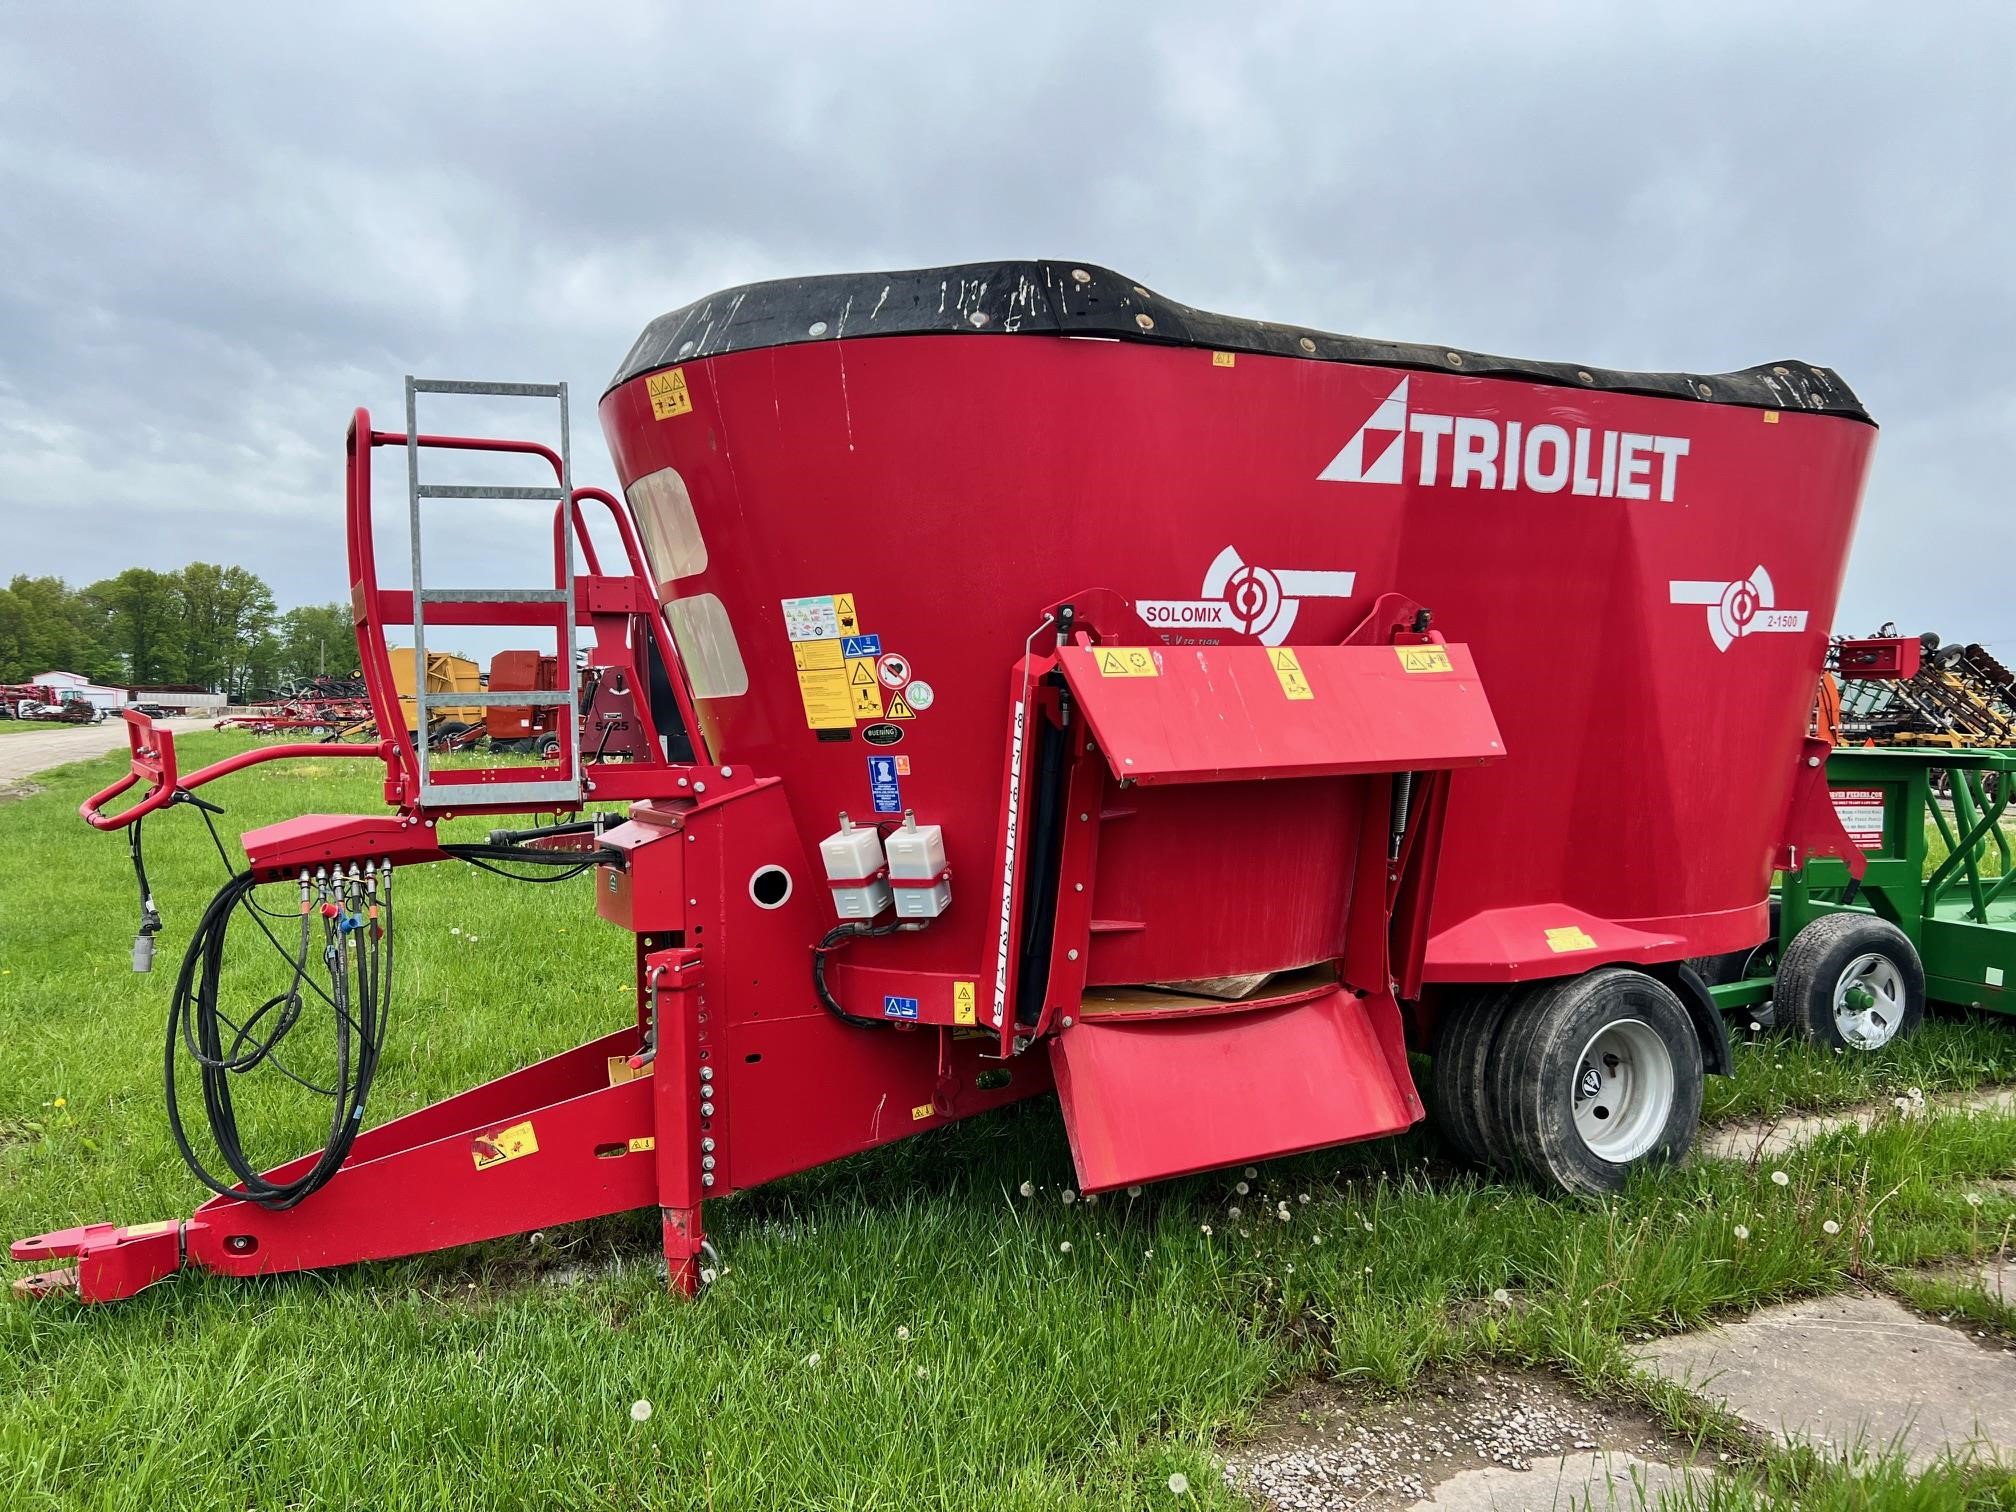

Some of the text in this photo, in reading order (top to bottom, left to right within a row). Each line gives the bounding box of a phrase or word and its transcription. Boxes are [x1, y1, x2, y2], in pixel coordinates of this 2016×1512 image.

[1409, 412, 1690, 503] TRIOLIET
[1146, 606, 1222, 622] SOLOMIX
[1767, 615, 1797, 627] 2-1500
[1017, 712, 1023, 729] 8
[1015, 749, 1020, 765] 7
[1012, 786, 1018, 803] 6
[1007, 860, 1013, 873] 4
[1002, 931, 1008, 946] 2
